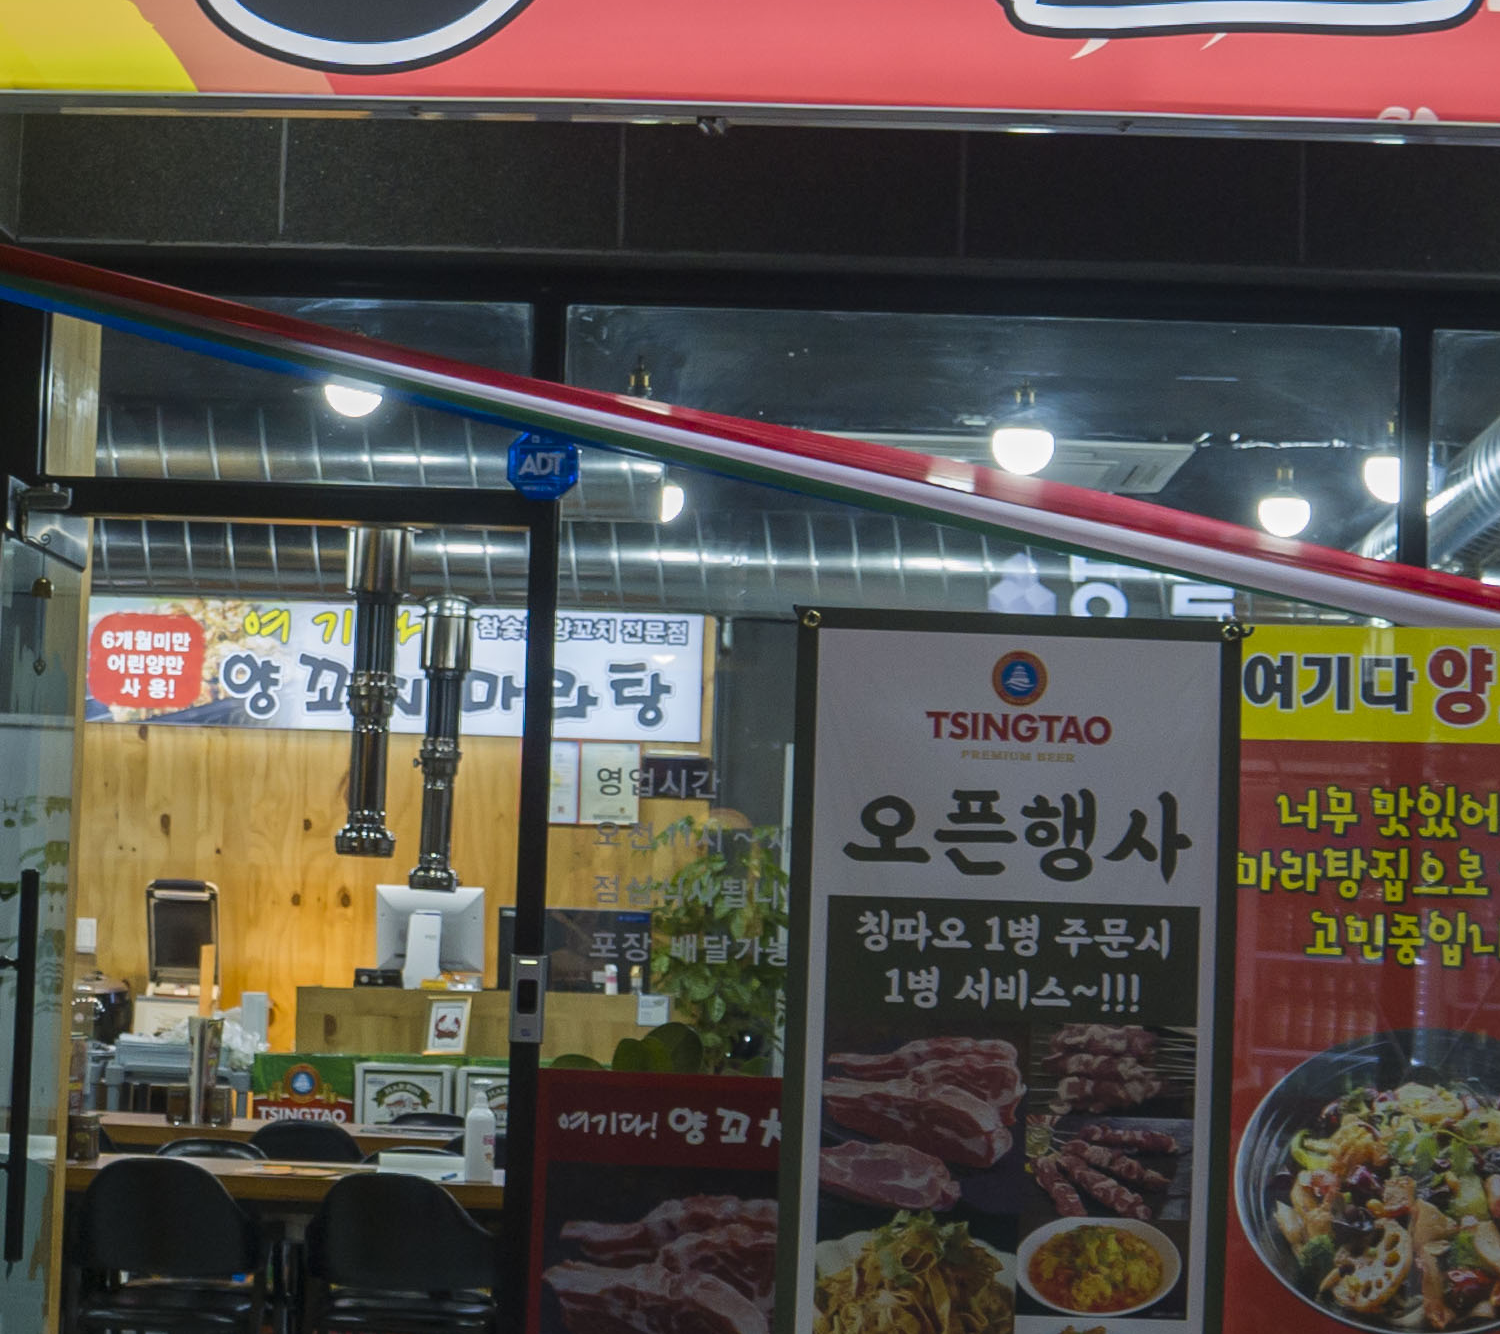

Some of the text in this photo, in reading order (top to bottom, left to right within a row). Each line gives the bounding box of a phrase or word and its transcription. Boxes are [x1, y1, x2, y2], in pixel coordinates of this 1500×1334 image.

[518, 451, 567, 476] ADT
[101, 630, 191, 653] 6개월미만
[477, 614, 528, 640] 참숯
[621, 619, 689, 645] 전문점
[107, 653, 185, 676] 어린양만
[1242, 650, 1414, 714] 여기다
[926, 710, 1113, 746] TSINGTAO
[596, 765, 720, 800] 영업시간
[1276, 788, 1359, 835] 너무
[842, 787, 1194, 885] 오픈행사
[1235, 847, 1489, 902] 마라탕집으로
[589, 932, 652, 964] 포장
[856, 909, 1172, 961] 칭따오 1병 주문시
[884, 965, 940, 1010] 1병
[257, 1106, 347, 1123] TSINGTAO
[557, 1110, 659, 1140] 여기다!
